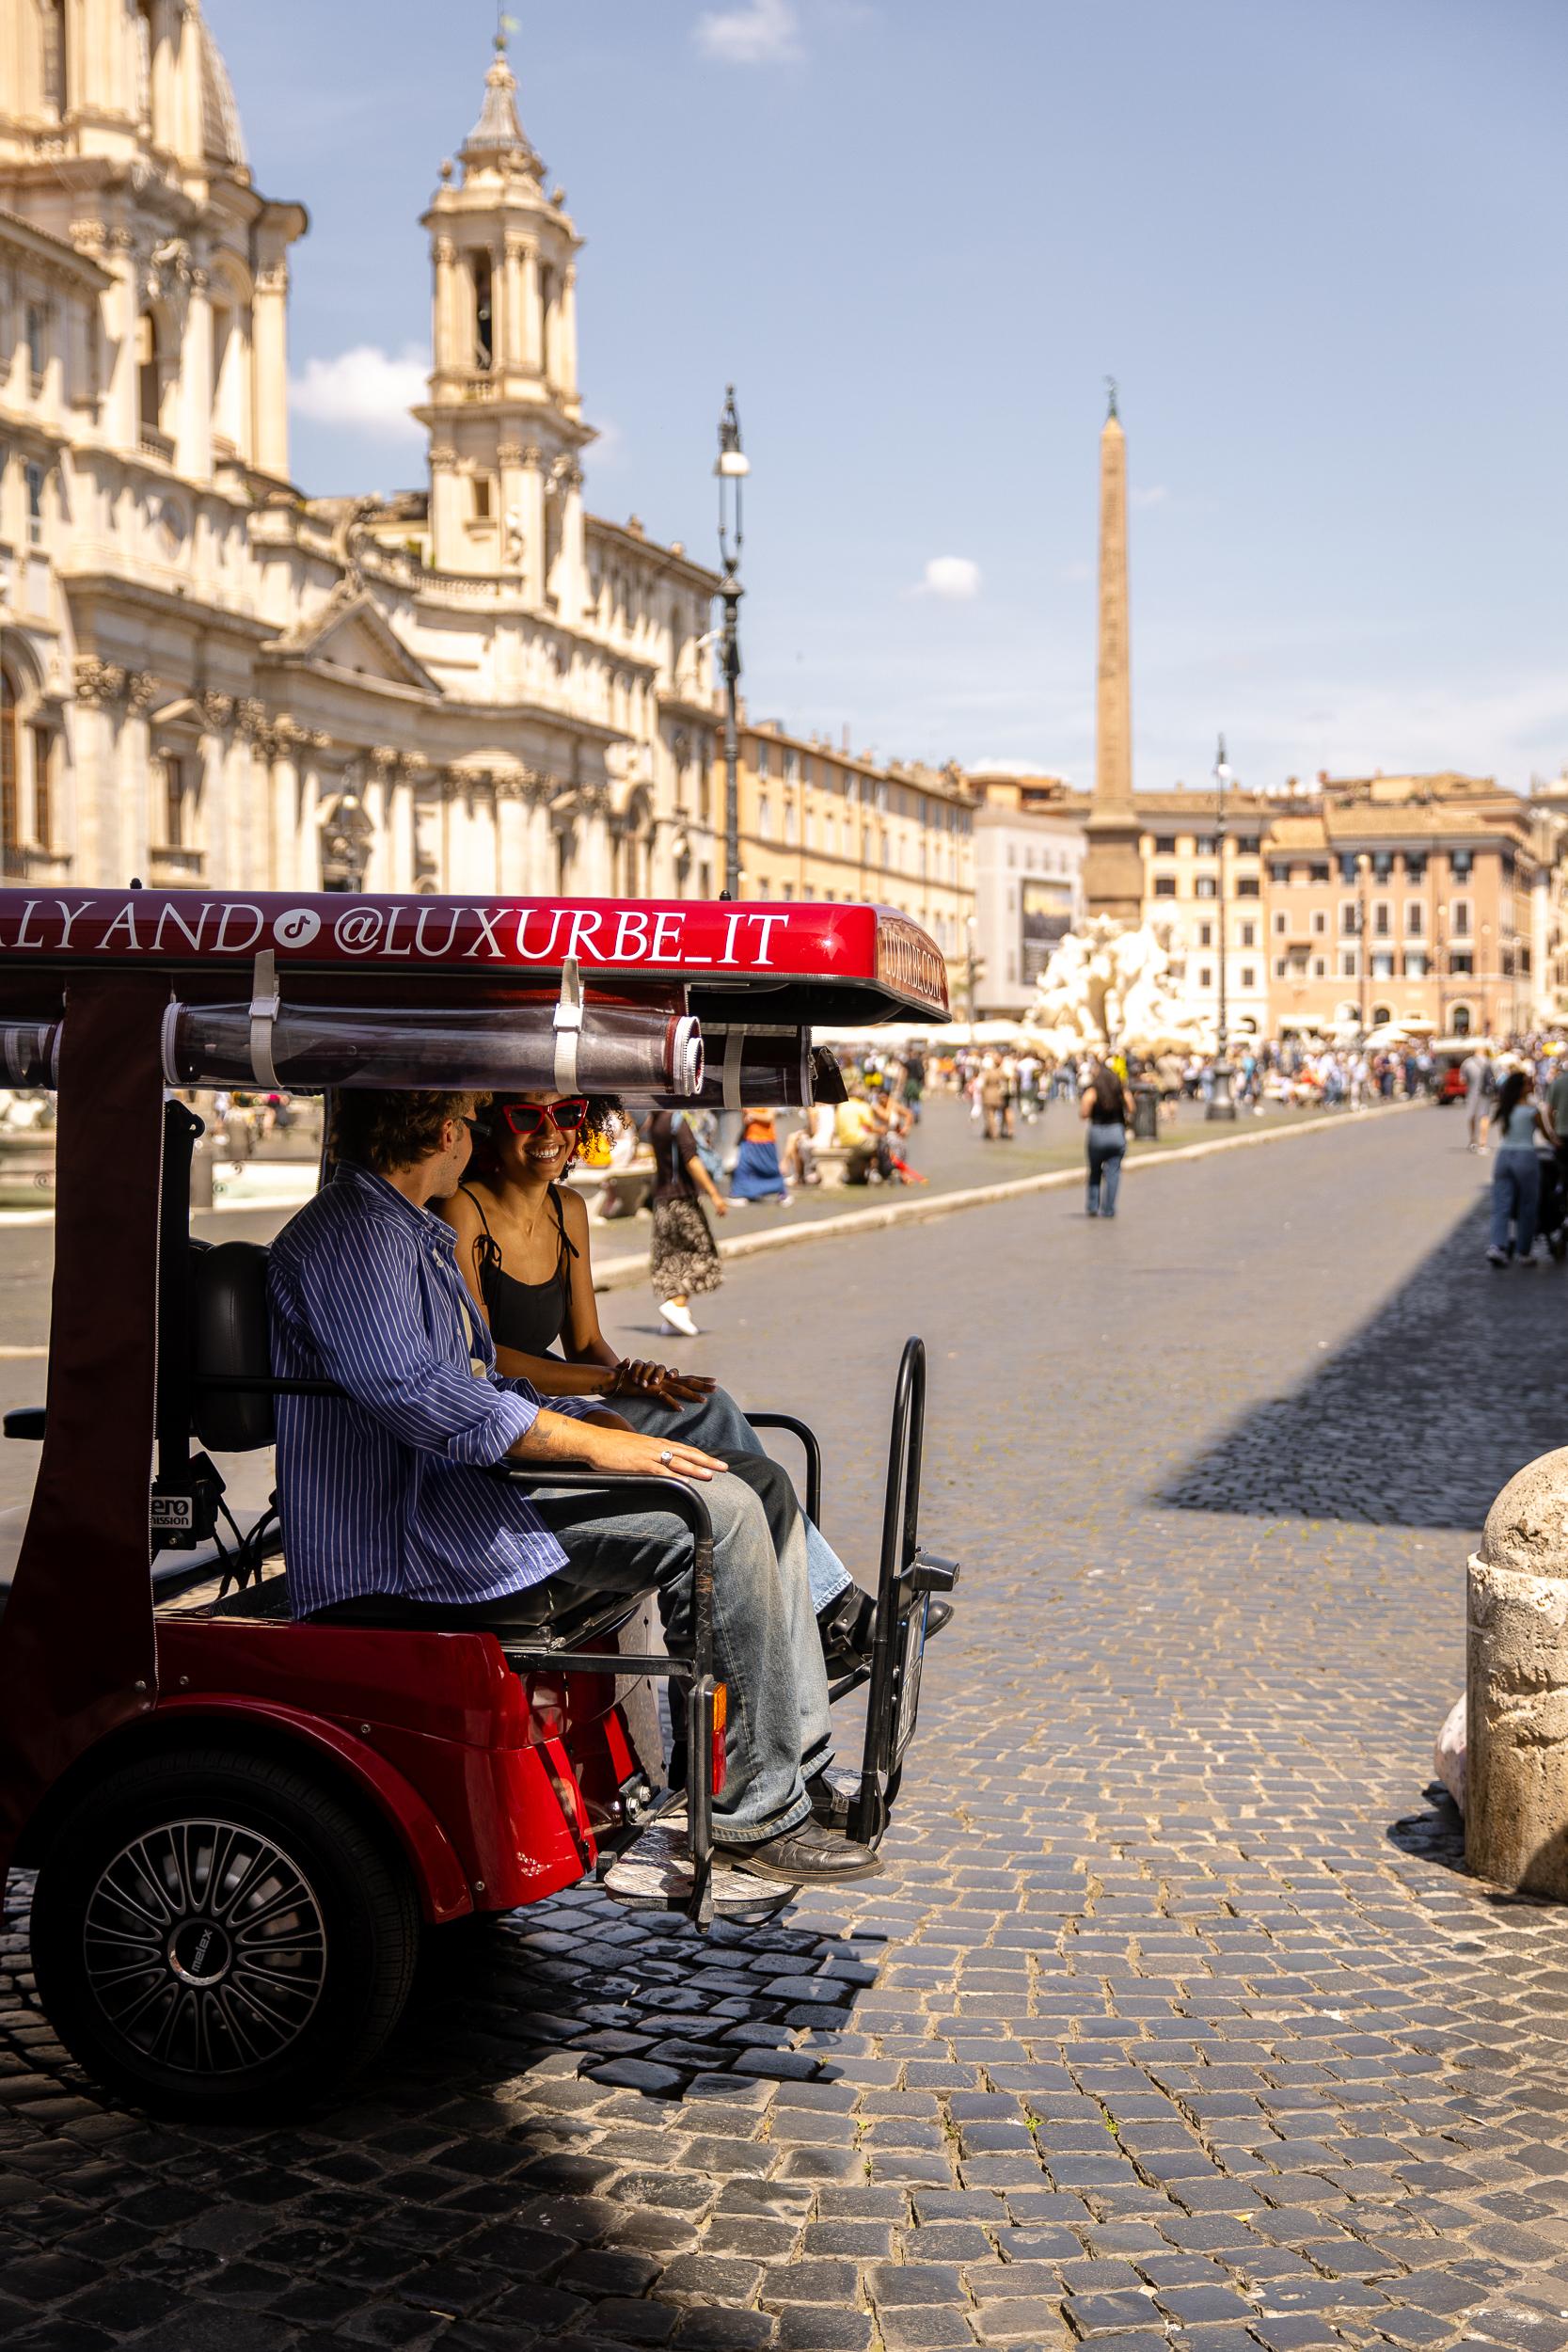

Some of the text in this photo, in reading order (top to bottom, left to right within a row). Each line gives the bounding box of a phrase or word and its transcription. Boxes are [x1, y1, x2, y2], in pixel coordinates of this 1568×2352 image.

[0, 900, 97, 948] LY
[334, 906, 789, 965] @LUXURBE_IT
[151, 1499, 189, 1516] ero
[191, 1929, 213, 1973] melex
